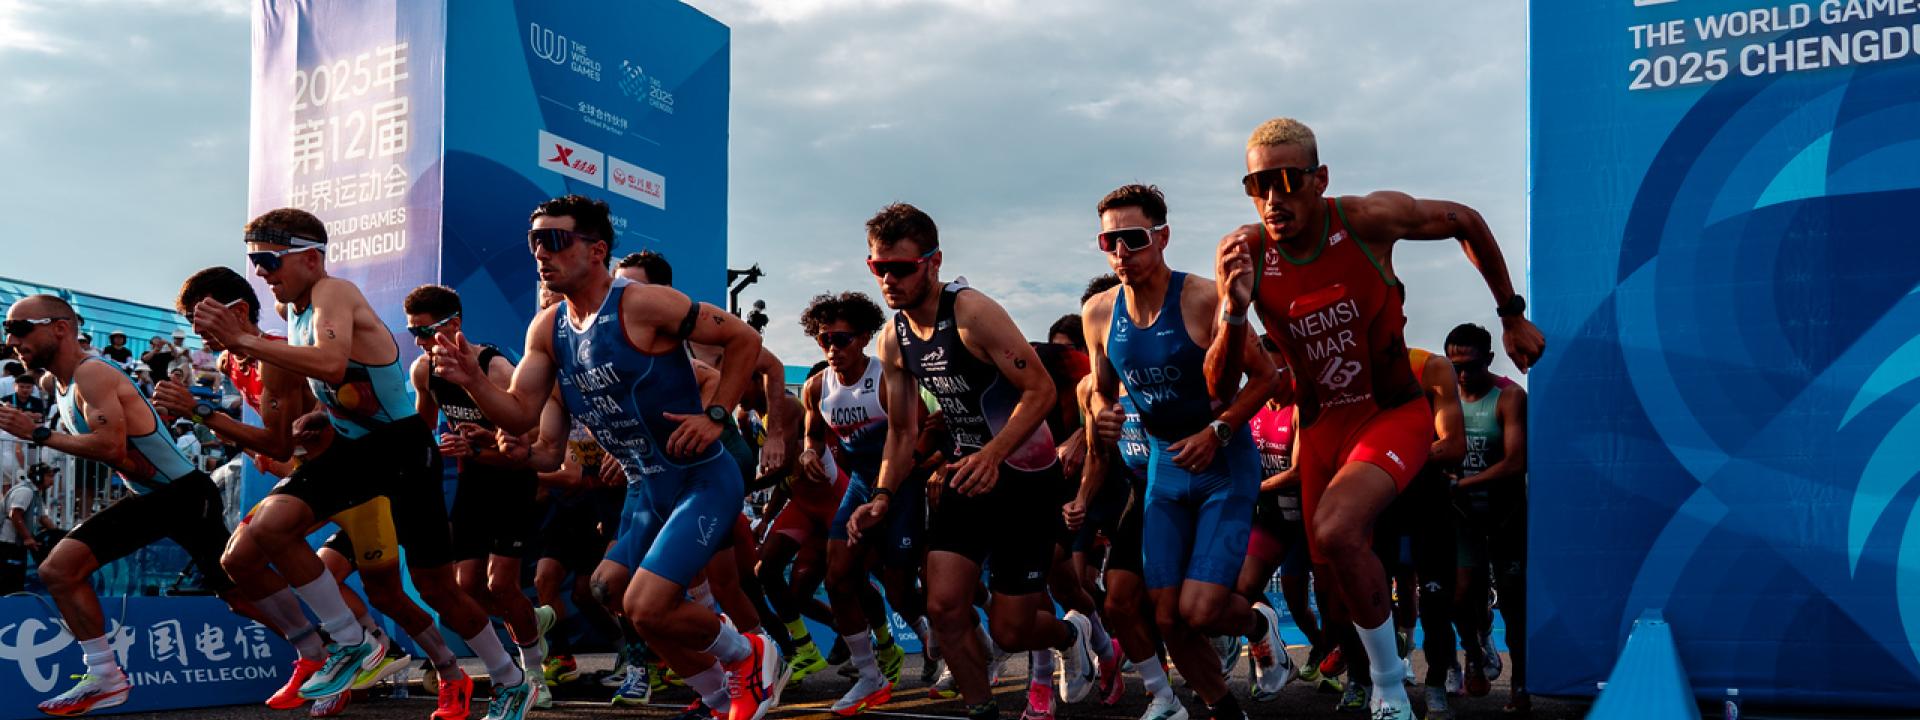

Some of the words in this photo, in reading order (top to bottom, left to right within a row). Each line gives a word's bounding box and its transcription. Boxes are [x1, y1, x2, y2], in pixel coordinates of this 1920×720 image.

[1628, 20, 1685, 49] THE
[1695, 4, 1810, 40] WORLD
[1820, 0, 1920, 25] GAME
[571, 40, 586, 55] THE
[571, 51, 602, 71] WORLD
[288, 42, 408, 112] 2025年
[571, 61, 601, 82] GAMES
[1628, 48, 1729, 90] 2025
[650, 85, 674, 106] 2025
[287, 96, 409, 174] 第12届
[286, 163, 407, 213] 世界运动会
[326, 217, 358, 238] ORLD
[361, 207, 406, 231] GAMES
[328, 230, 406, 263] CHENGDU
[1289, 300, 1360, 339] NEMSI
[1305, 330, 1357, 361] MAR
[1123, 365, 1182, 386] KUBO
[592, 394, 624, 415] FRA
[831, 406, 869, 425] ACOSTA
[126, 670, 177, 687] HINA
[181, 665, 278, 683] TELECOM
